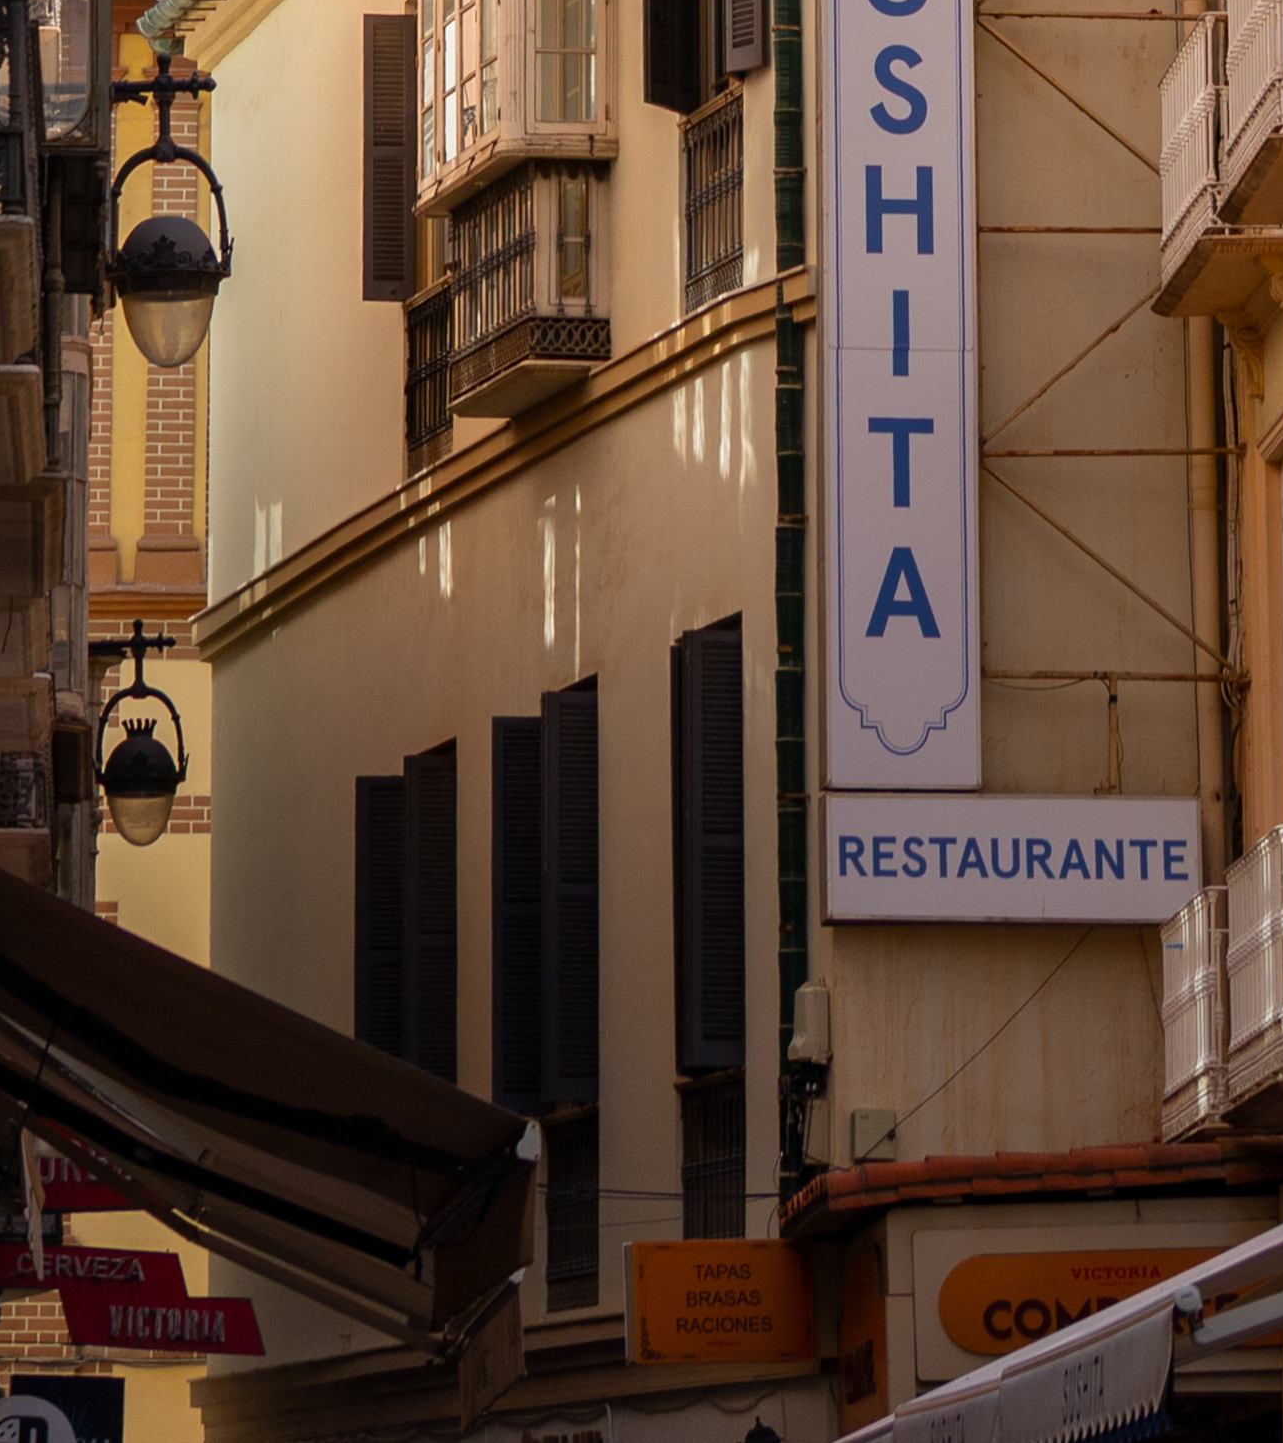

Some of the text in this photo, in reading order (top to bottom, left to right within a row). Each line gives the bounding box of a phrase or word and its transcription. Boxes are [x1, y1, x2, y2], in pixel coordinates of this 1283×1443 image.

[838, 835, 1189, 880] RESTAURANTE
[15, 1251, 146, 1282] CERVEZA
[693, 1264, 752, 1280] TAPAS
[1071, 1265, 1161, 1281] VICTORIA
[687, 1290, 762, 1307] BRASAS
[108, 1304, 226, 1344] VICTORIA
[676, 1316, 773, 1334] RACIONES
